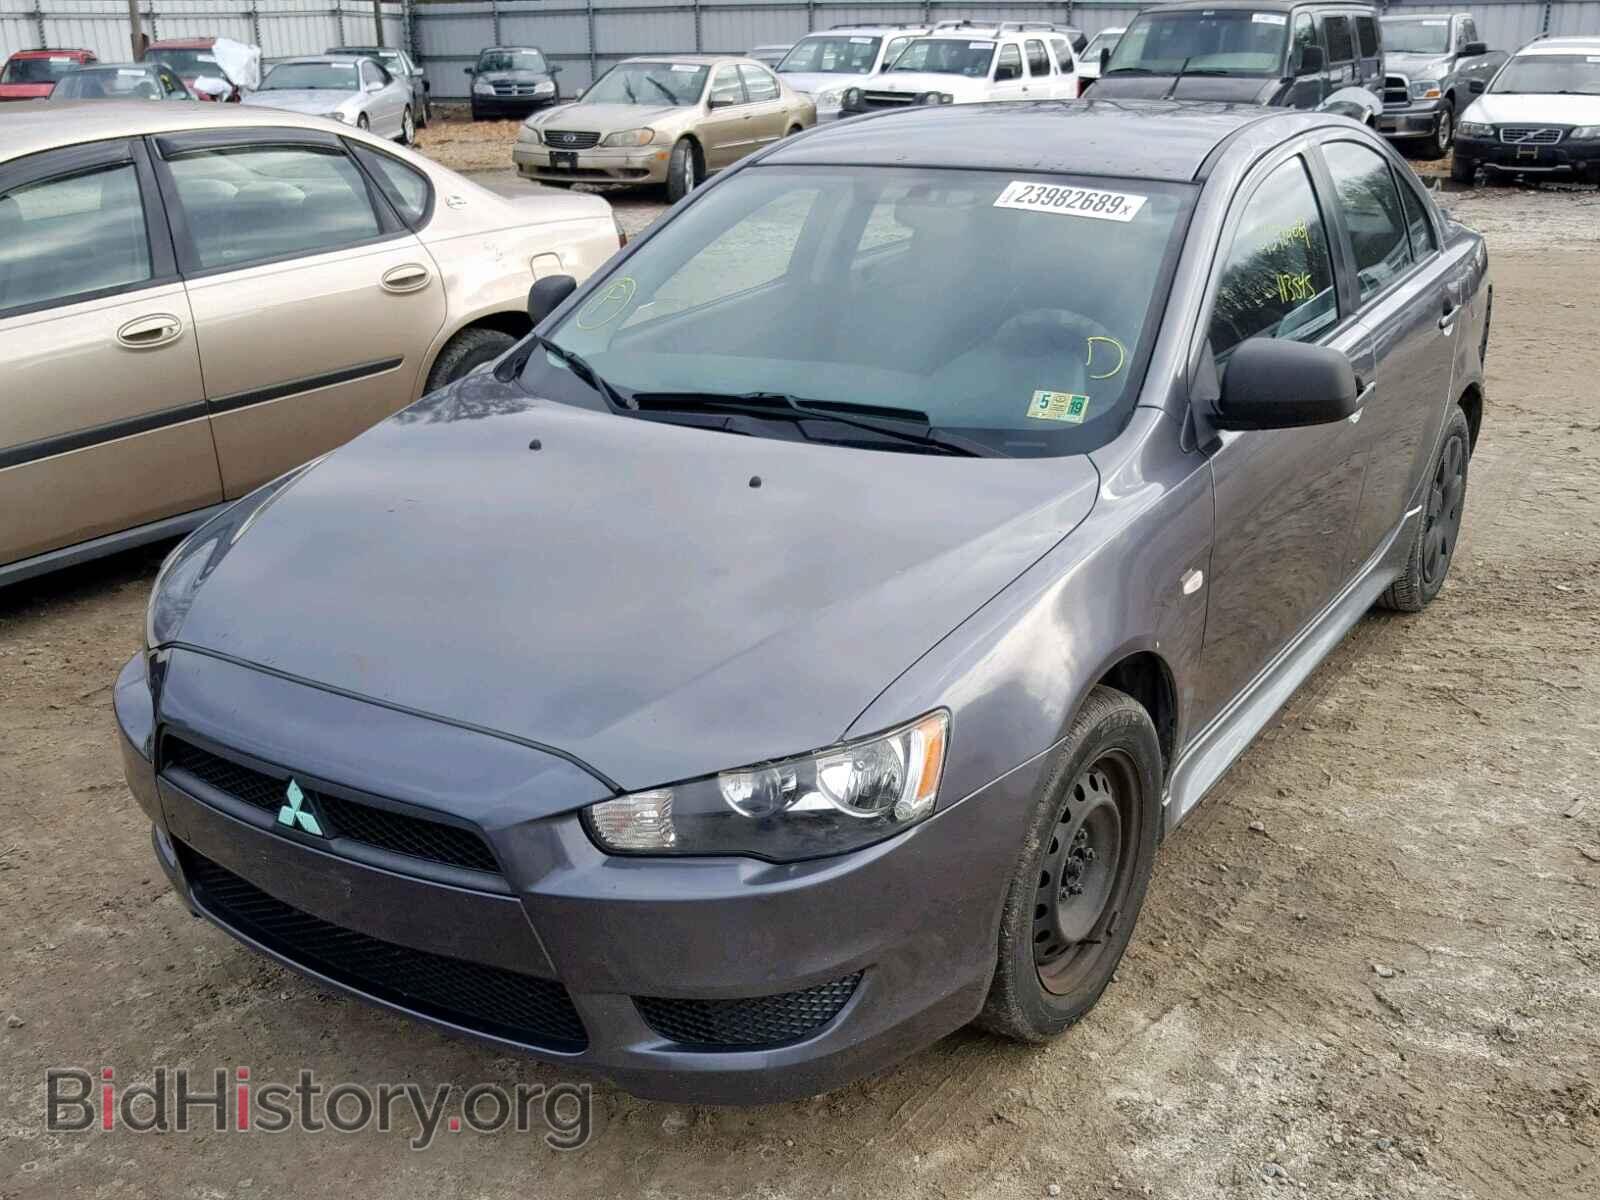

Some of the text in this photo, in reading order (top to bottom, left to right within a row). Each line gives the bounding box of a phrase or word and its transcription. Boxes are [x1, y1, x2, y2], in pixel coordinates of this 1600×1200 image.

[1085, 335, 1125, 379] D
[1039, 394, 1052, 409] 5
[1070, 400, 1083, 415] 19
